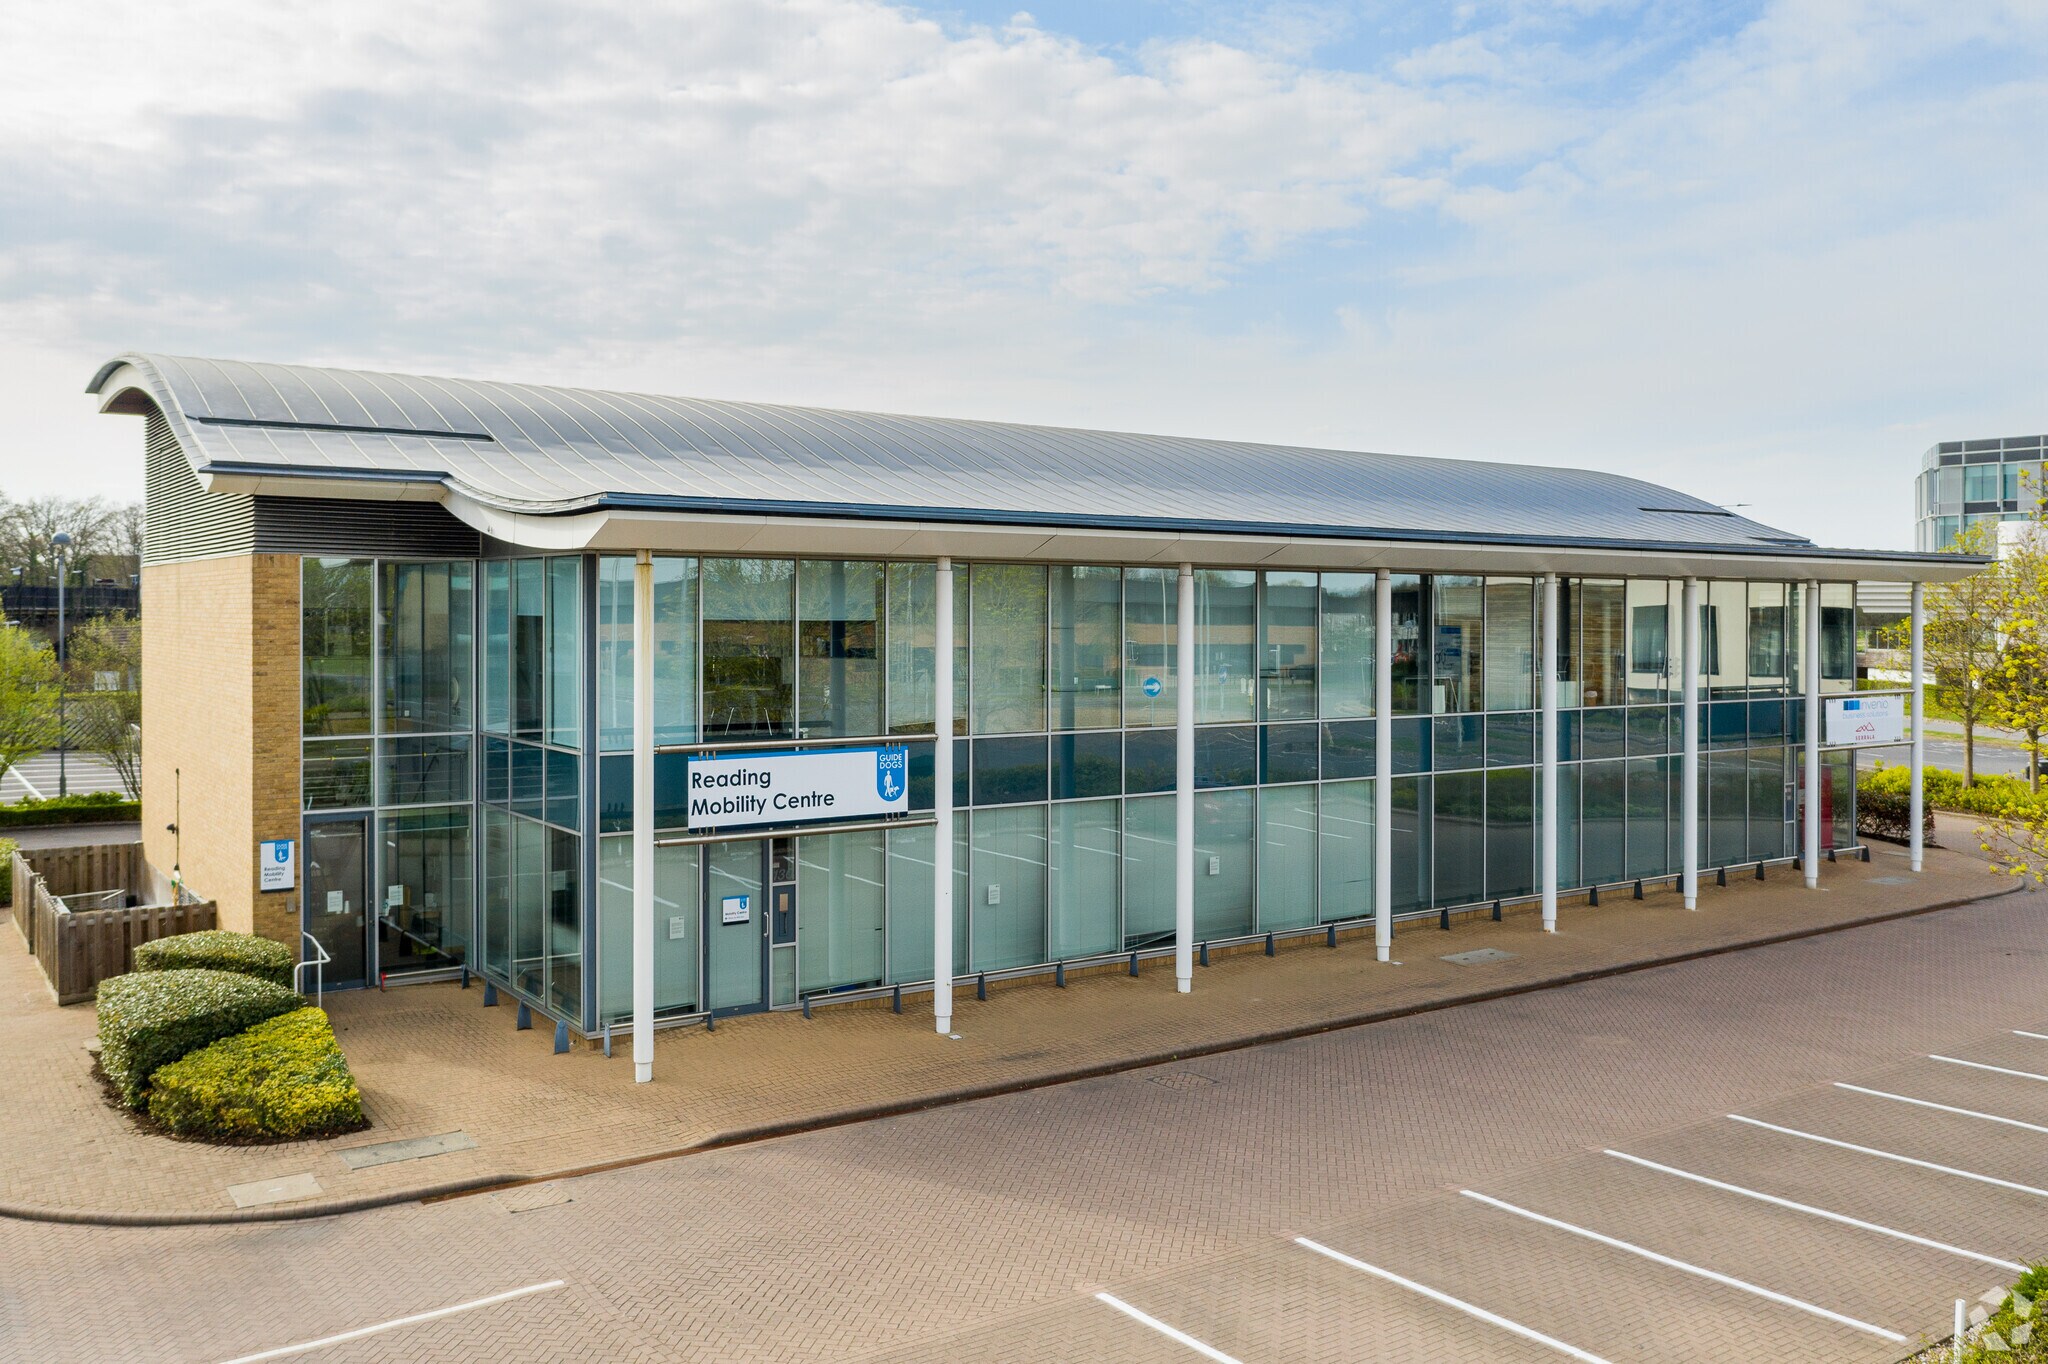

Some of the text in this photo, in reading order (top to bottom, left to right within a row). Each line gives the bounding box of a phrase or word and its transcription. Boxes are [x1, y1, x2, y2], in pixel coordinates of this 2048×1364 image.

[879, 753, 903, 762] GUIDE
[880, 760, 903, 769] DOGS
[691, 768, 771, 789] Reading
[691, 790, 835, 816] Mobility Centre
